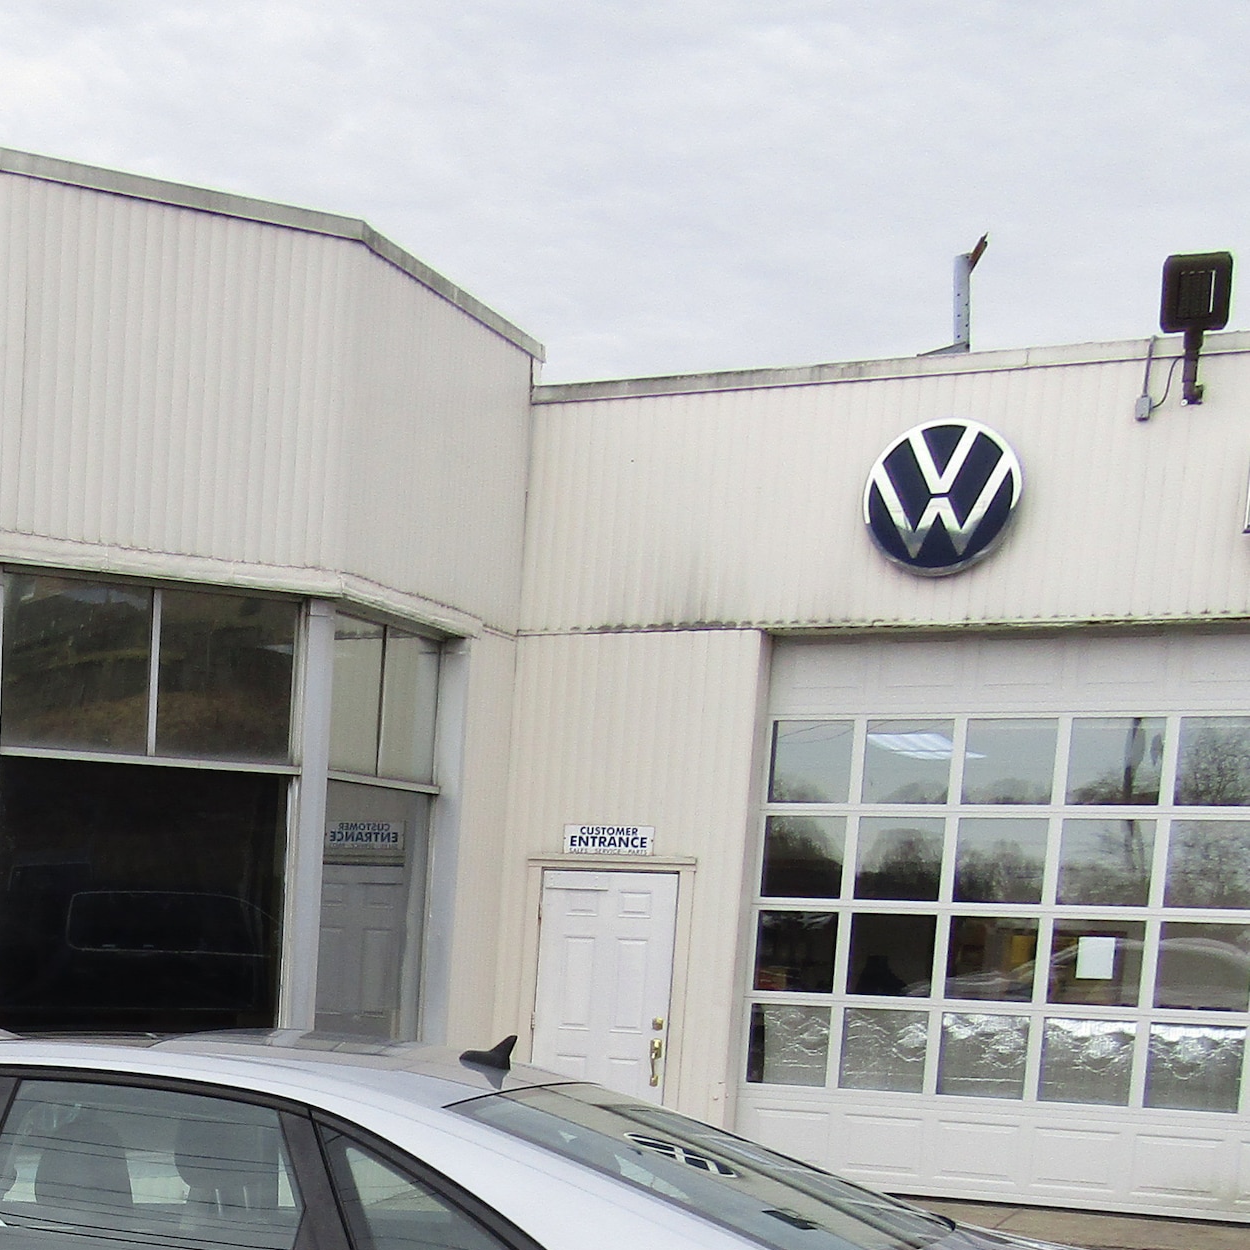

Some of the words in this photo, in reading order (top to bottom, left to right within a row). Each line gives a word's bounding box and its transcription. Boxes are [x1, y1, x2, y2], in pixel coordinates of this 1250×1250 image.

[865, 420, 1020, 565] VW
[580, 826, 638, 836] CUSTOMER
[570, 835, 648, 848] ENTRANCE
